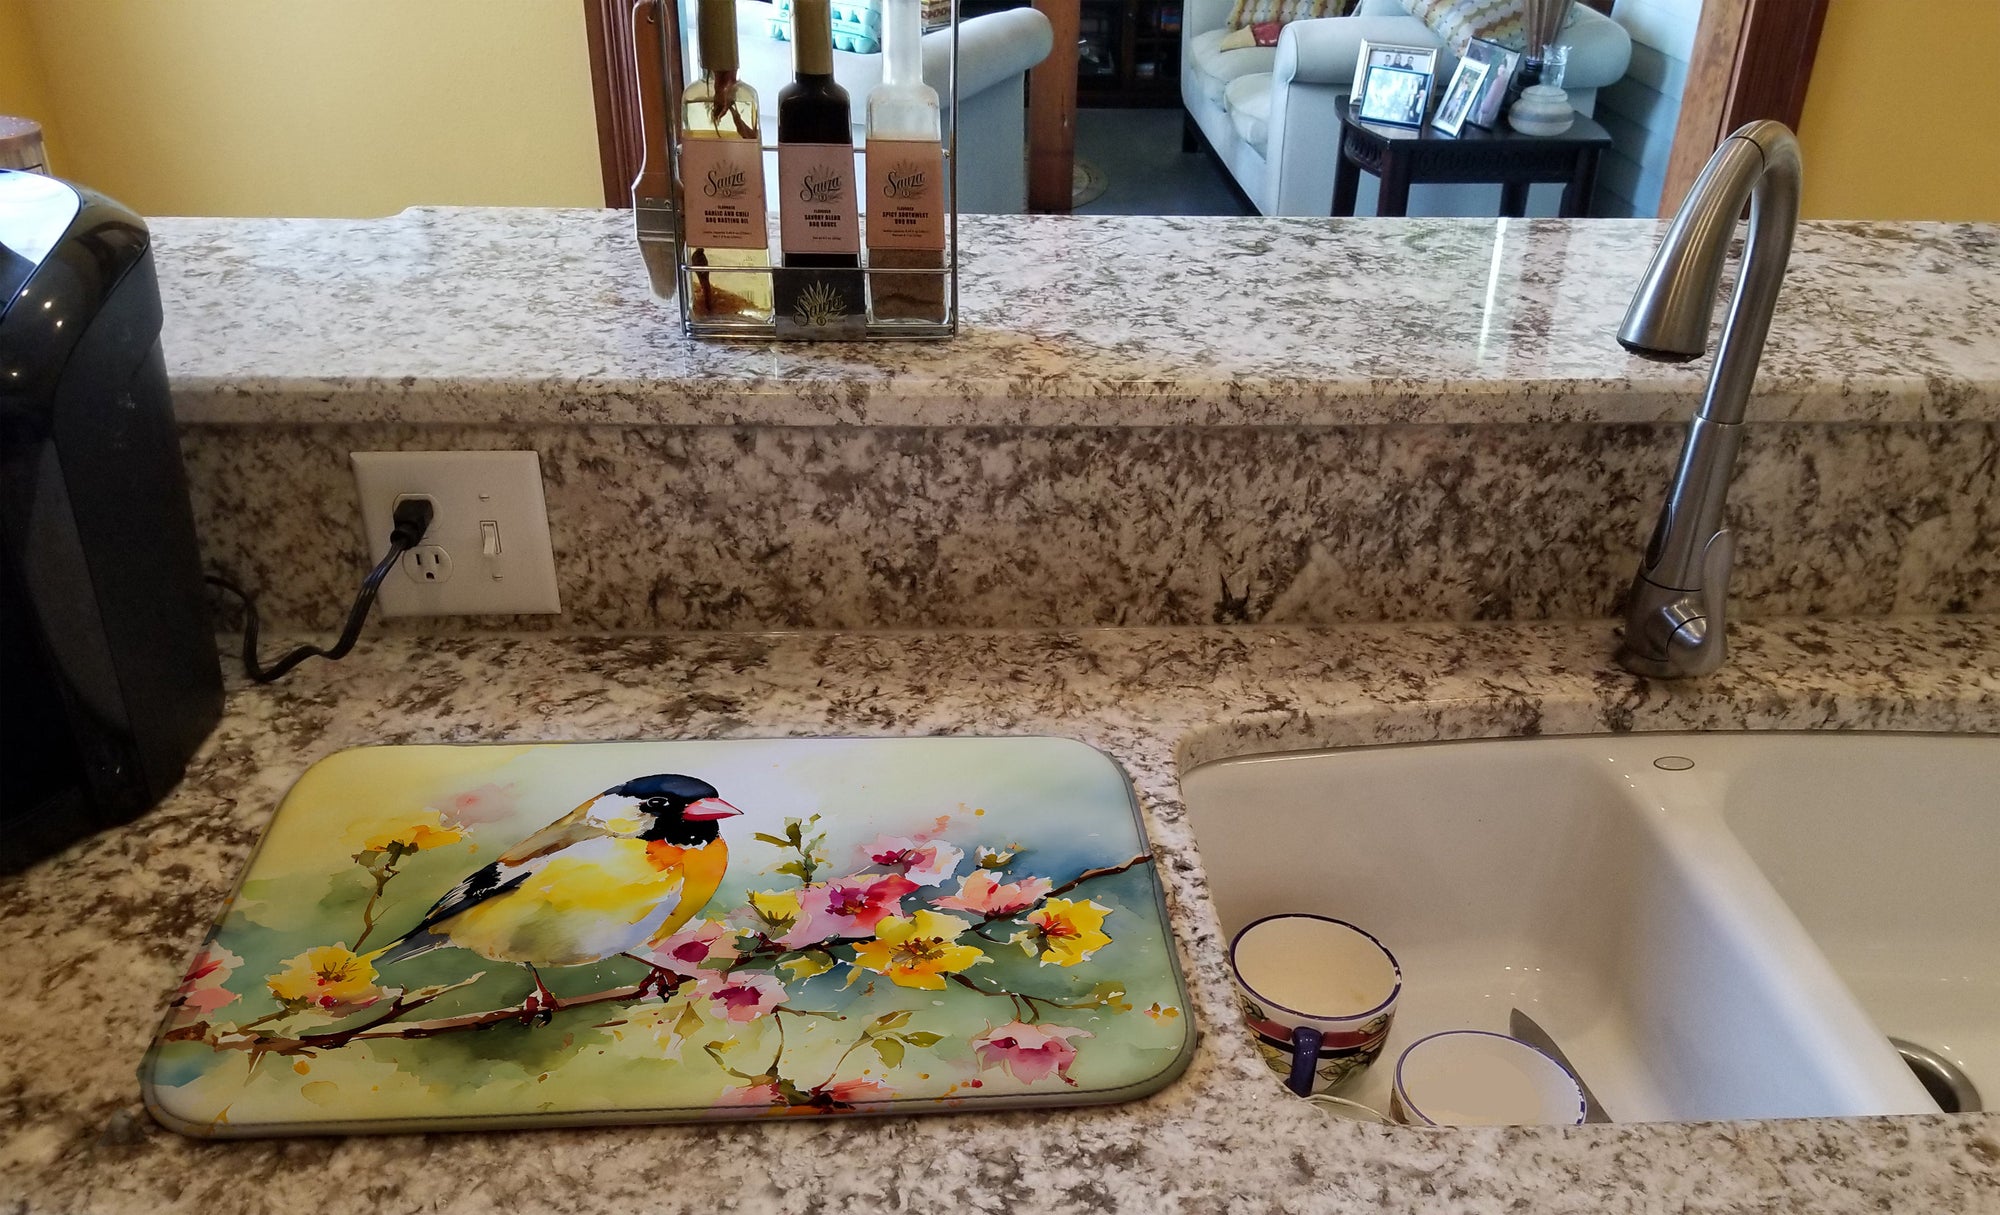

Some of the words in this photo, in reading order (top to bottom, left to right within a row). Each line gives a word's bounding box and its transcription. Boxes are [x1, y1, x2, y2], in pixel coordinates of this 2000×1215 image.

[703, 170, 745, 197] Sauza
[800, 175, 841, 202] Sauza
[883, 171, 925, 198] Sauza
